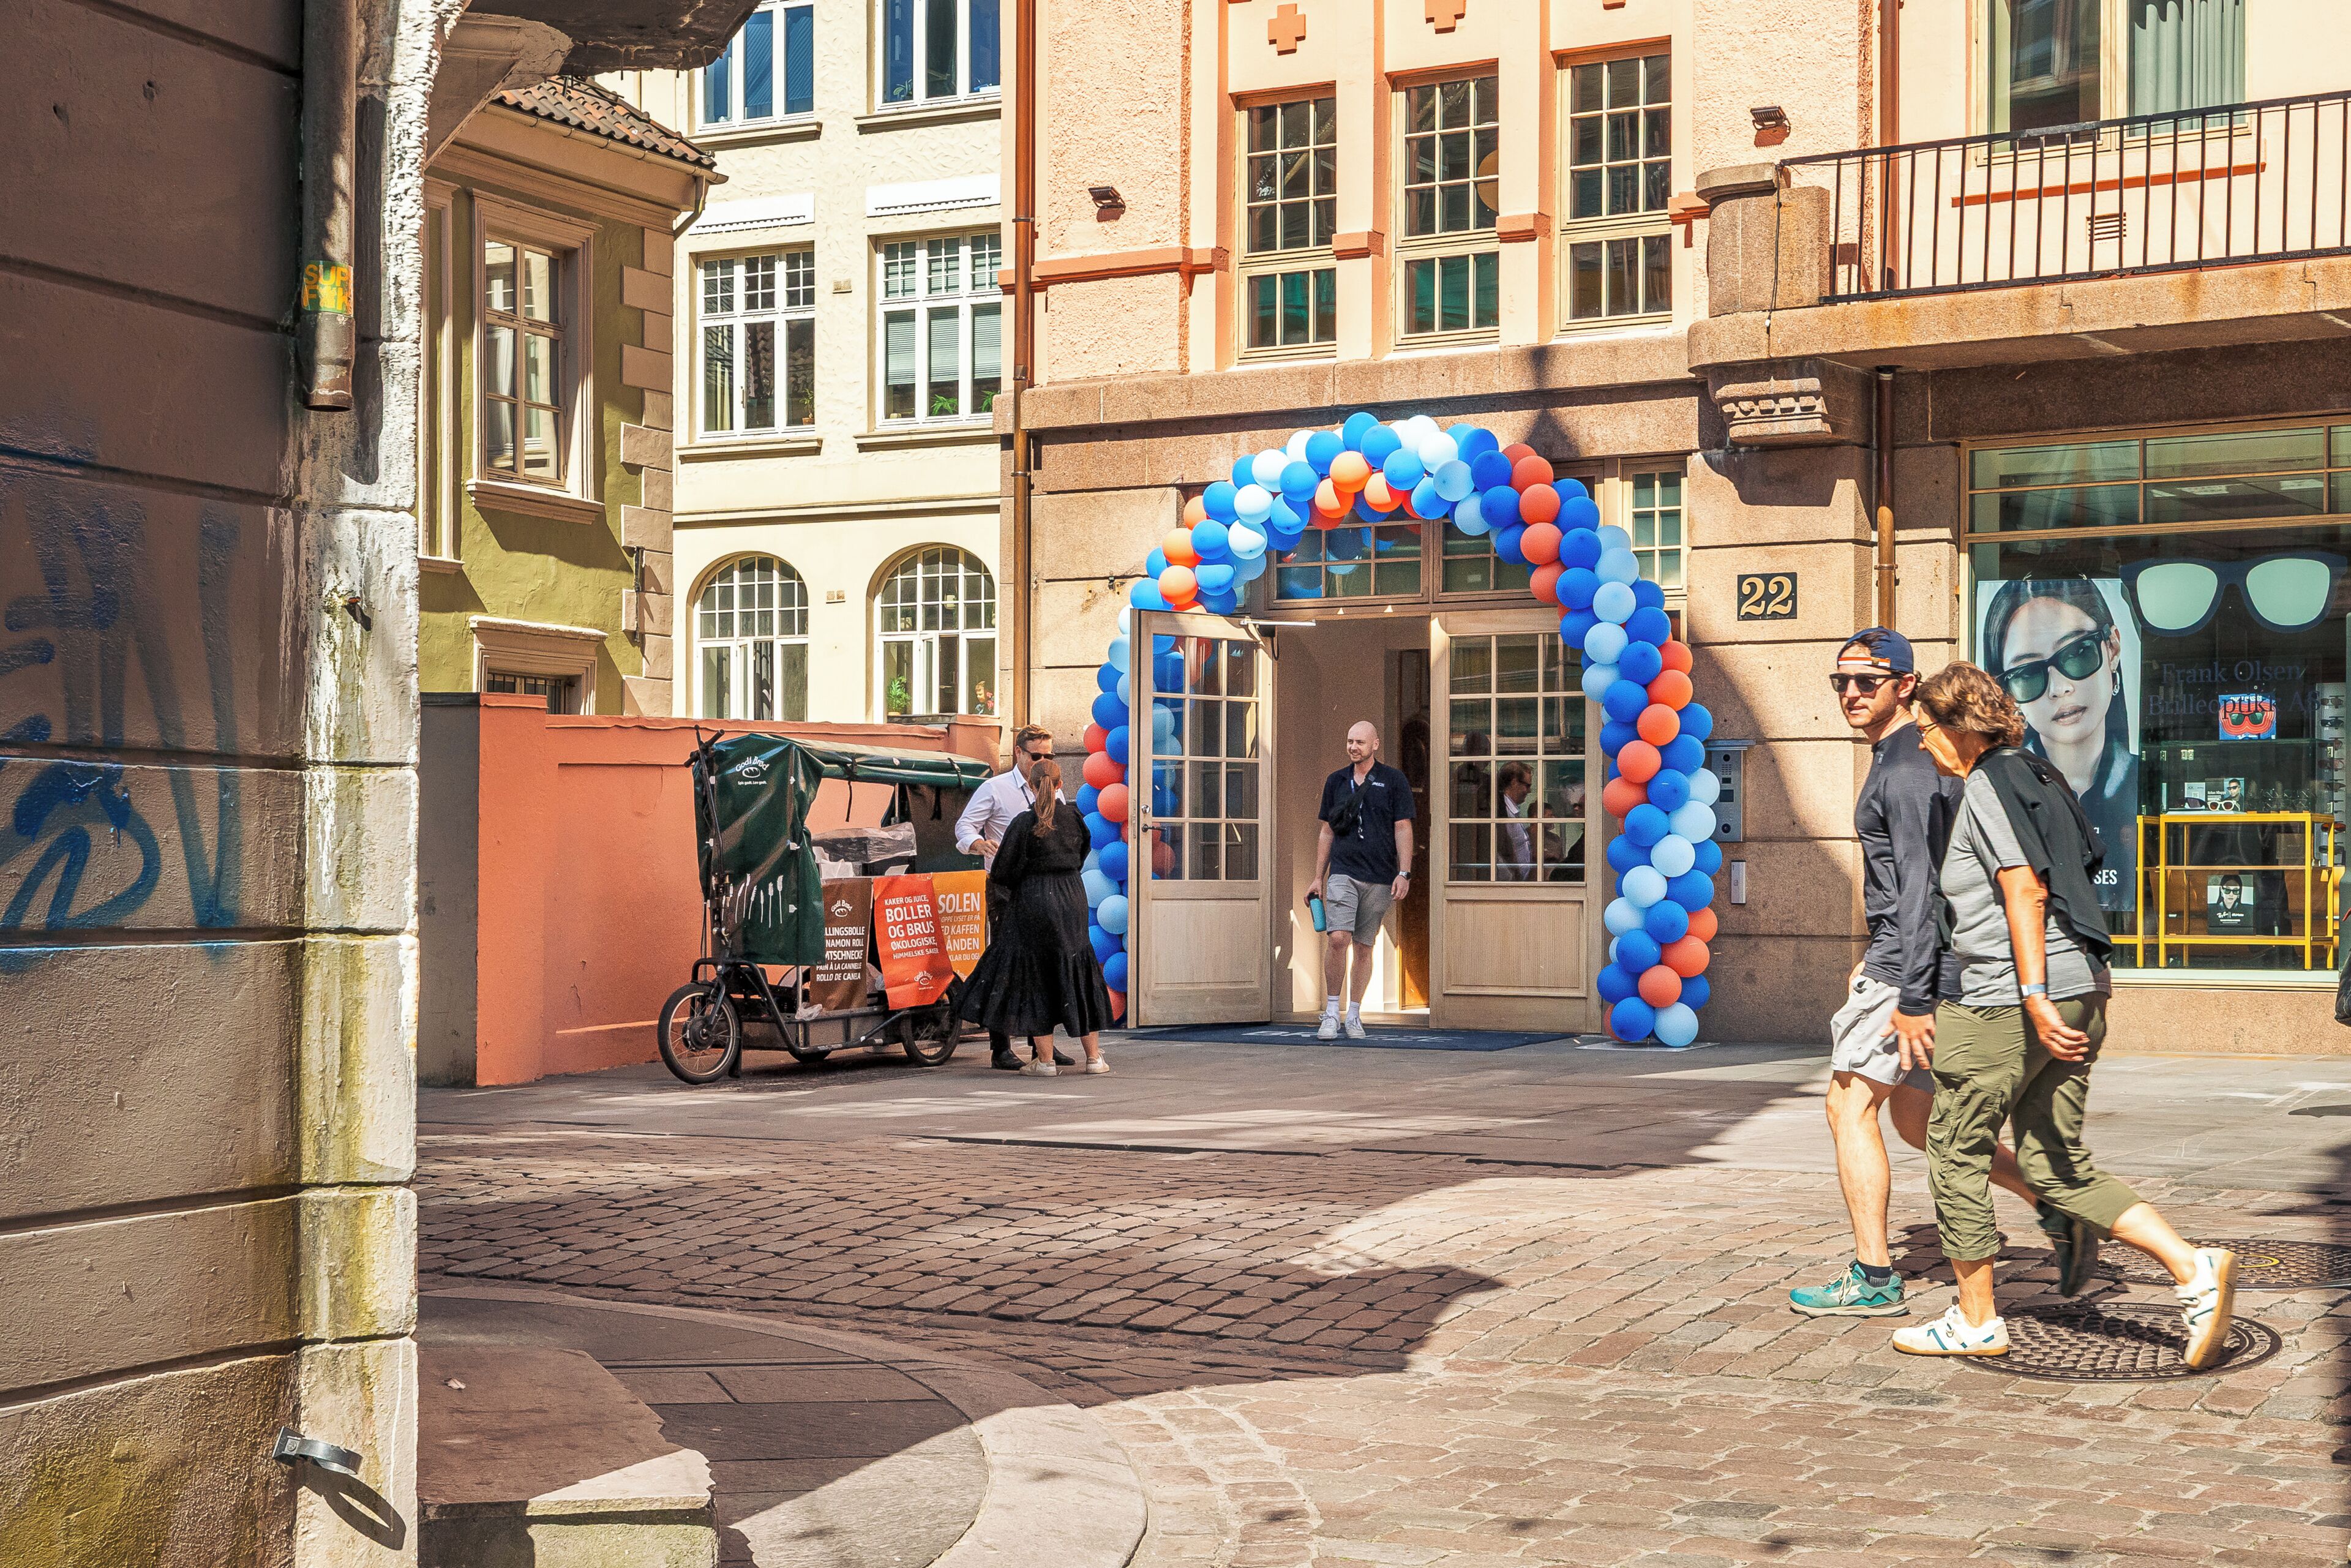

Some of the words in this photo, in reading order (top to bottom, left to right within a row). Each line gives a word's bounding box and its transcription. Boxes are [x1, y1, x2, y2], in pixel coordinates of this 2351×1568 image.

[1740, 576, 1793, 616] 22
[2161, 662, 2227, 685] Frank
[2234, 660, 2303, 681] Olsen
[2094, 869, 2117, 885] SES
[938, 892, 980, 914] SOLEN
[885, 904, 932, 923] BOLLER
[825, 926, 865, 936] LLINGSBOLLE
[888, 925, 905, 939] OG
[906, 921, 935, 936] BRUS
[951, 924, 979, 935] KAFFEN
[825, 939, 850, 948] NAMON
[852, 938, 864, 947] ROLL
[891, 936, 937, 951] ØKOLOGISKE,
[946, 936, 979, 951] ÅNDEN
[893, 949, 924, 959] HIMMELSKE
[1240, 1030, 1464, 1043] BREZE
